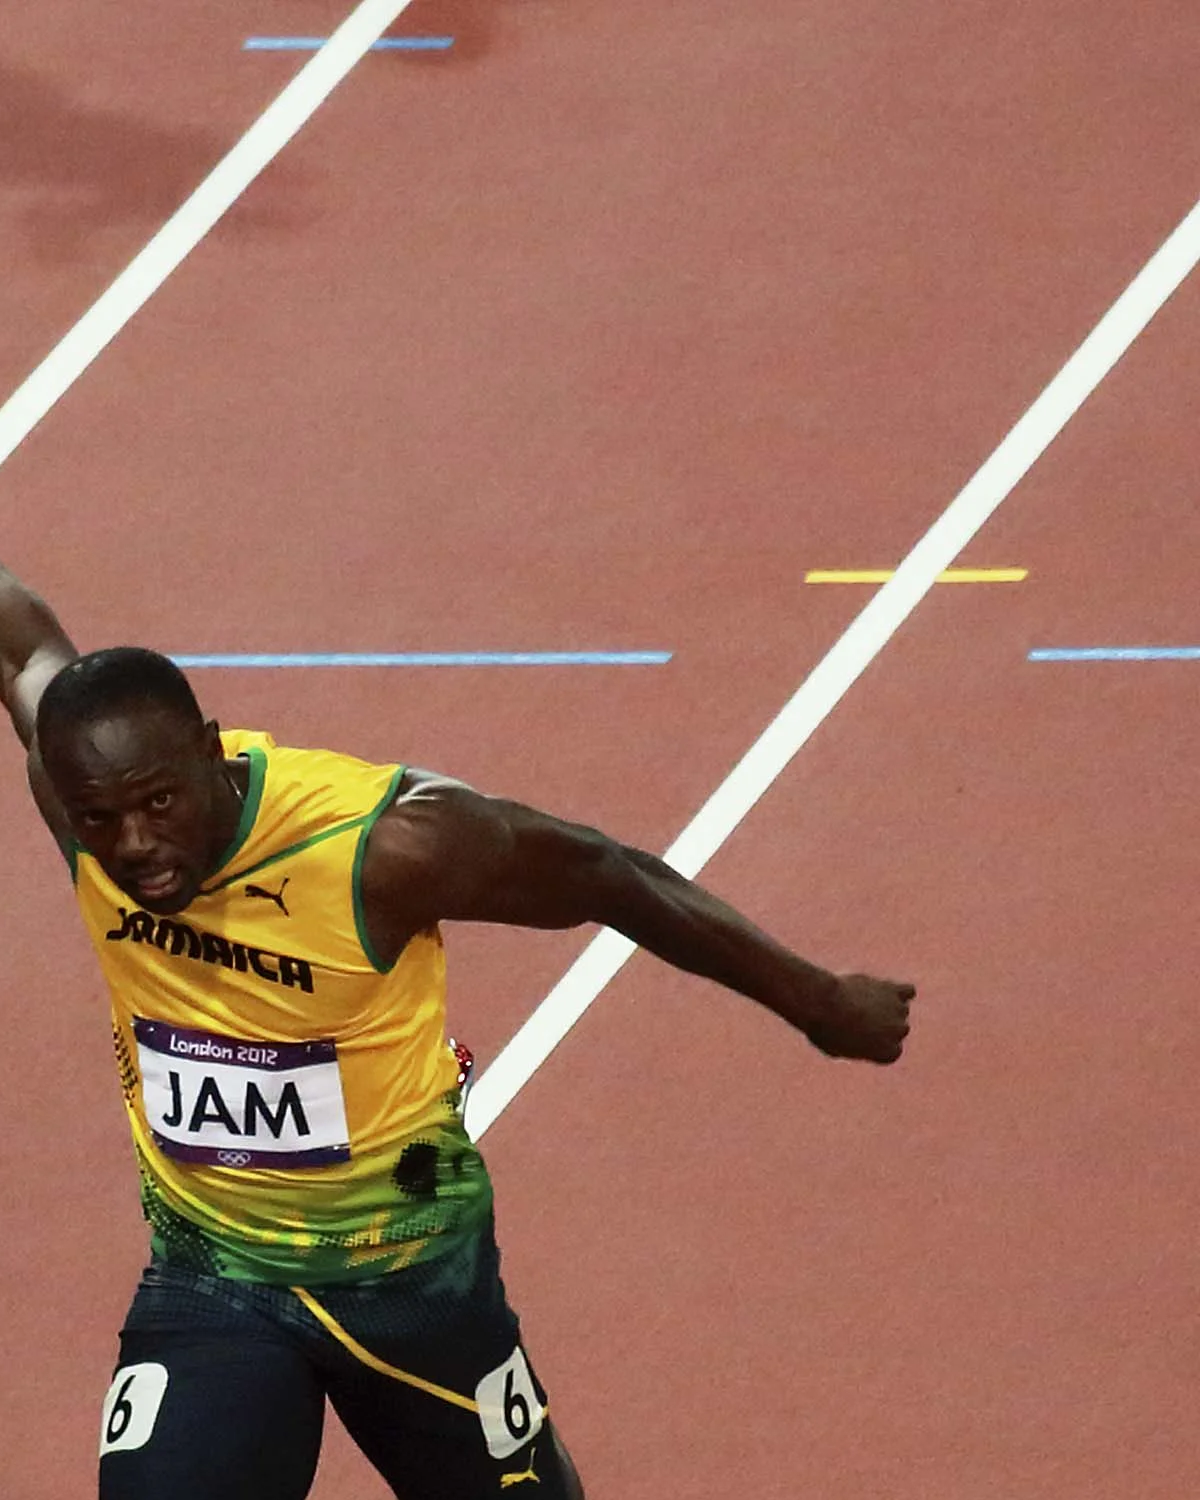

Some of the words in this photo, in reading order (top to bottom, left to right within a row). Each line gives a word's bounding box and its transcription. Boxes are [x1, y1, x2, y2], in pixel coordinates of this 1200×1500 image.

[106, 907, 314, 994] JAMAICA
[169, 1033, 233, 1060] London
[237, 1046, 279, 1066] 2012
[162, 1070, 311, 1139] JAM
[106, 1374, 137, 1444] 6
[503, 1368, 532, 1440] 6
